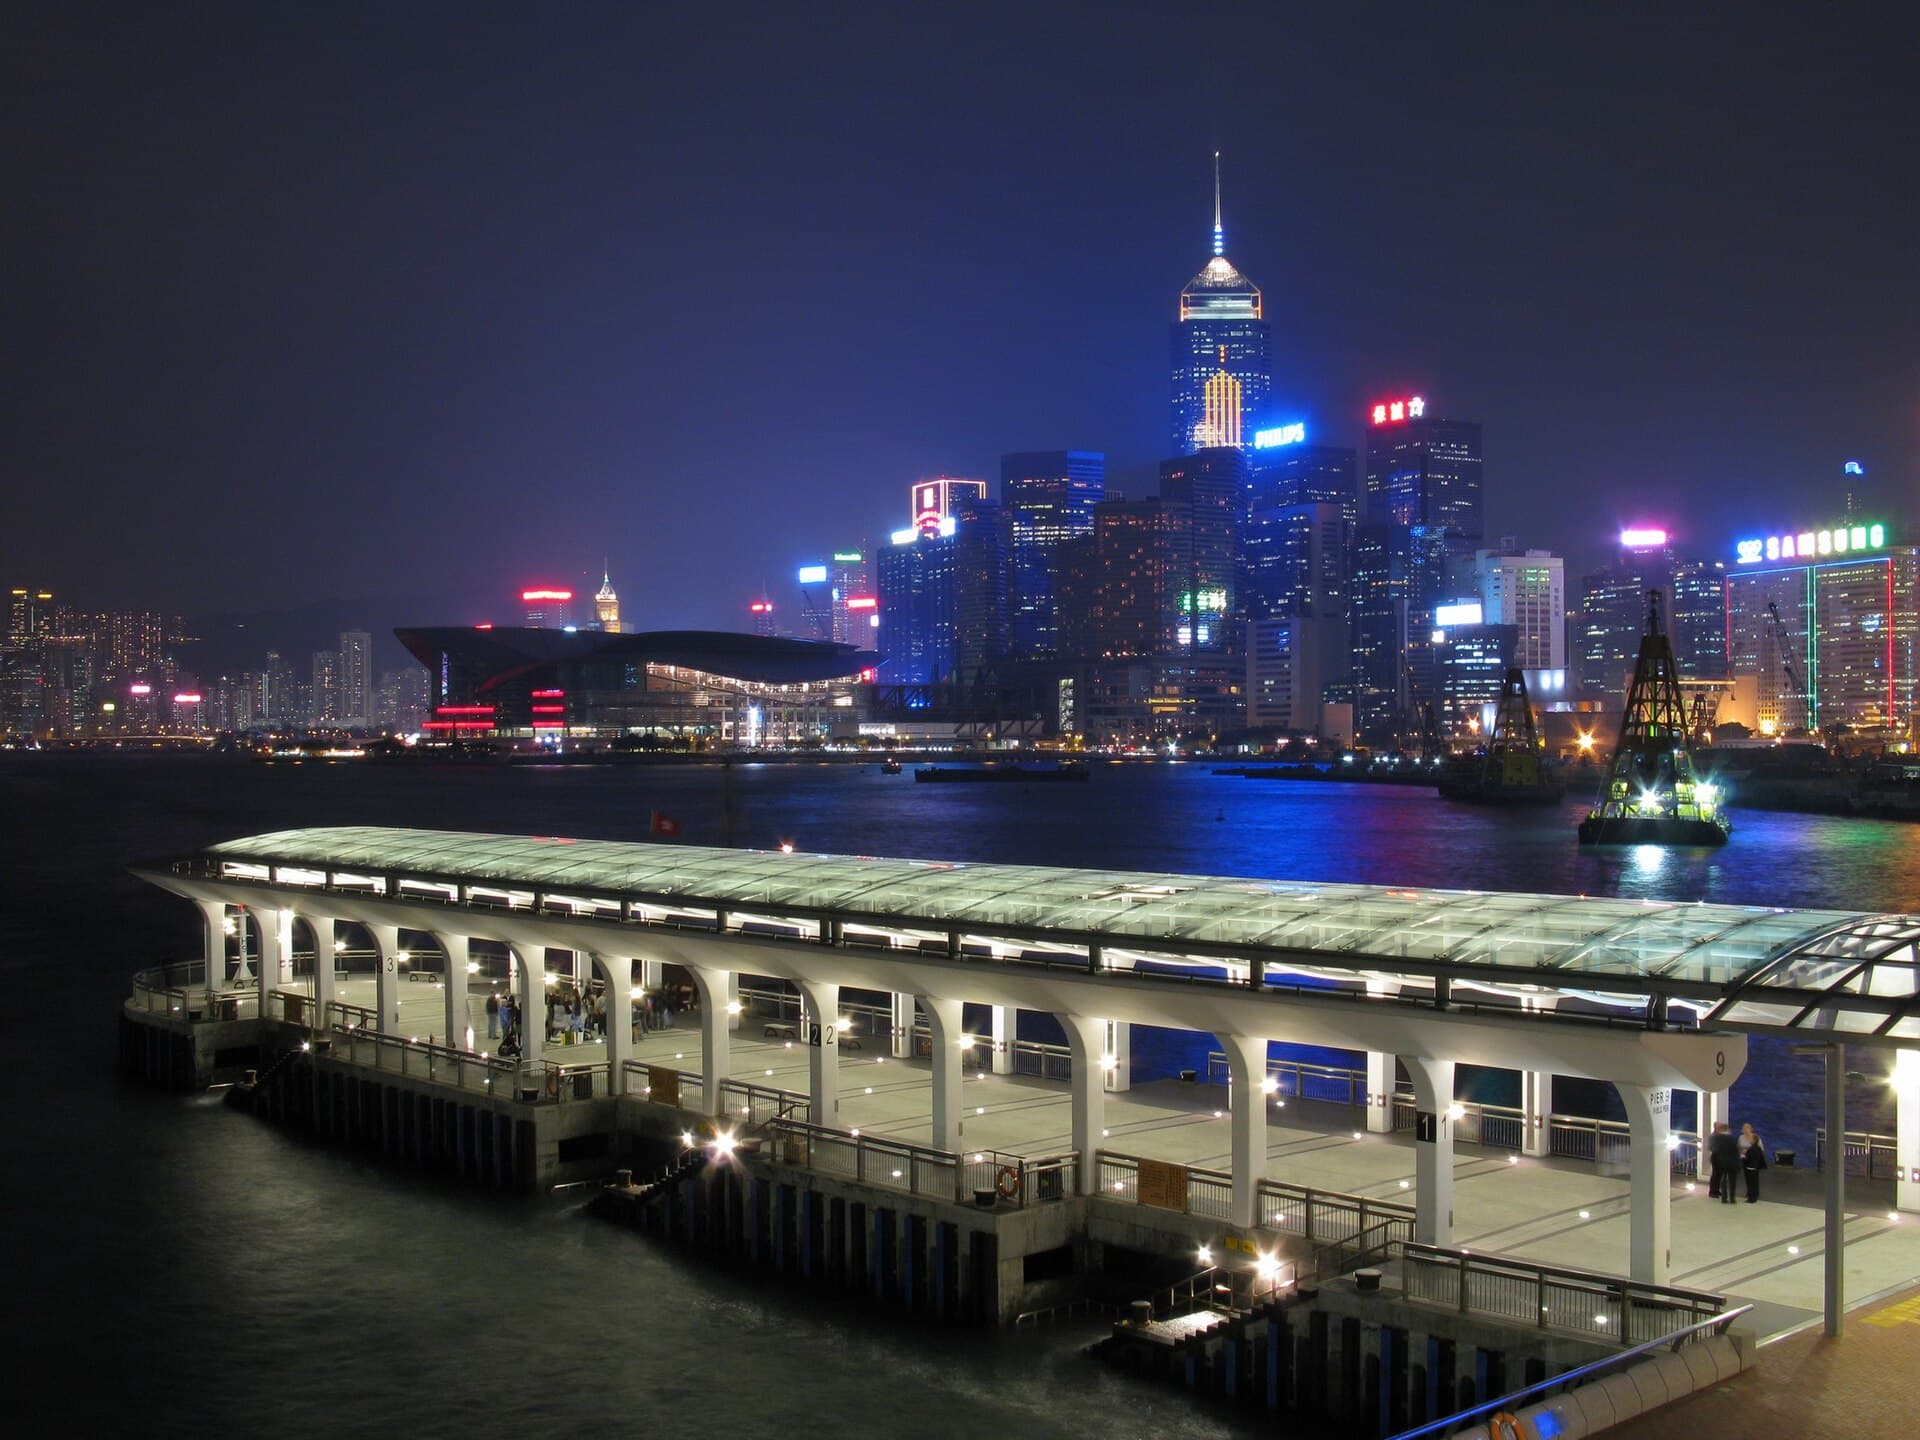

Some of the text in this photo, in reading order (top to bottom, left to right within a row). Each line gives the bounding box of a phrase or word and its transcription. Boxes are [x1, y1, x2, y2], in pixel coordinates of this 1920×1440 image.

[1254, 422, 1304, 450] PHILIPS
[1766, 524, 1884, 560] SAMSUNG
[386, 956, 394, 973] 3
[826, 1025, 834, 1045] 2
[1716, 1051, 1725, 1076] 9
[1650, 1091, 1664, 1105] PIER
[1422, 1114, 1429, 1140] 1
[1441, 1113, 1447, 1140] 1
